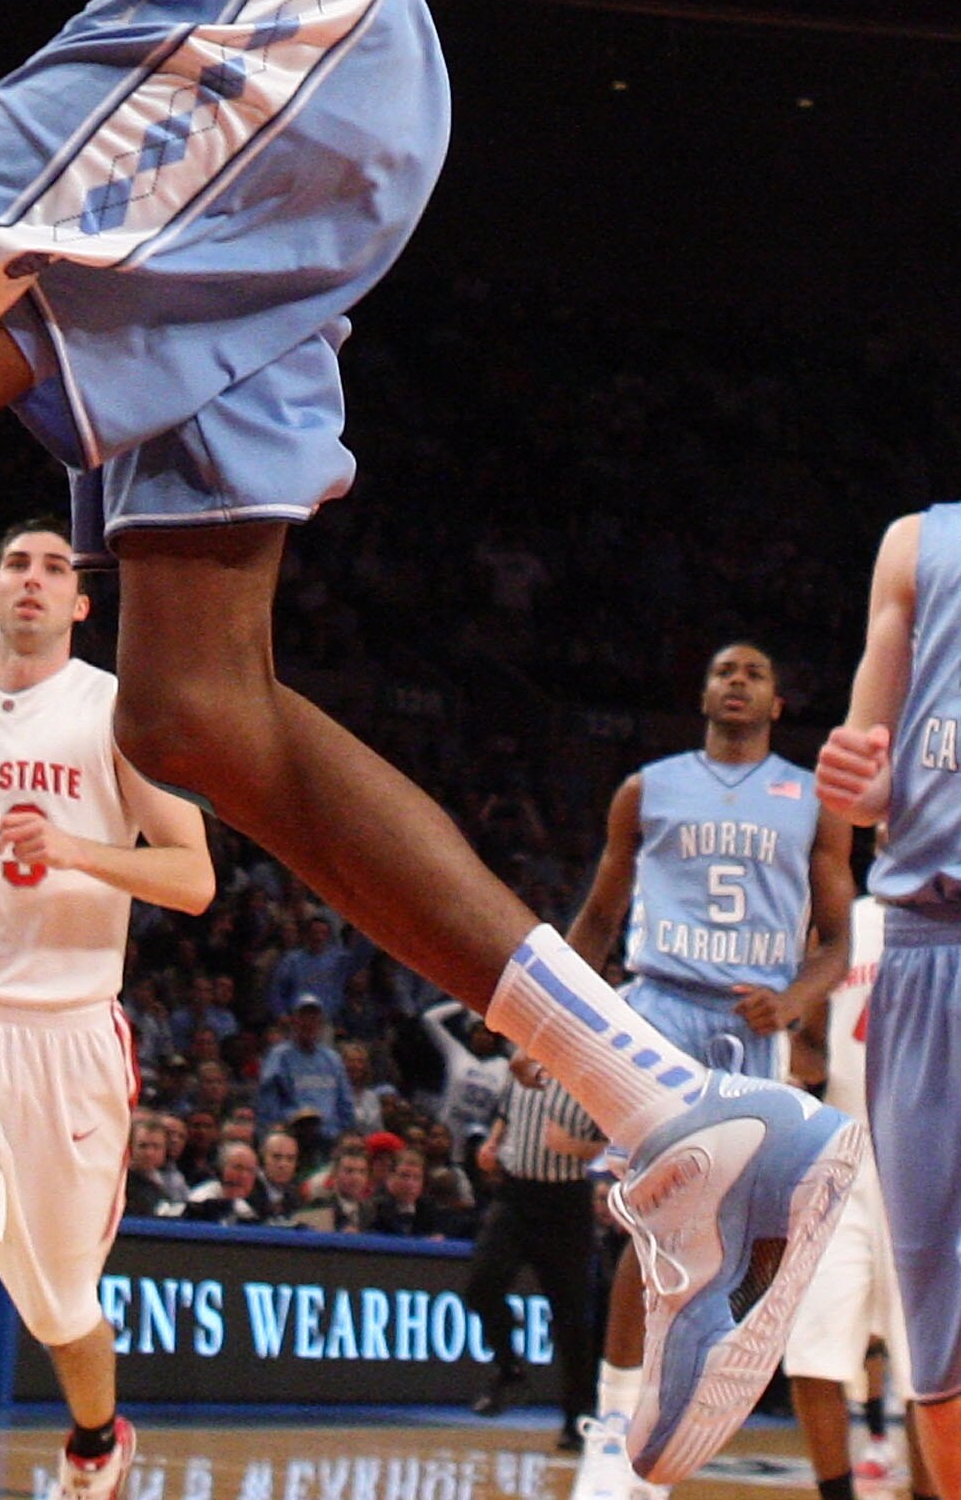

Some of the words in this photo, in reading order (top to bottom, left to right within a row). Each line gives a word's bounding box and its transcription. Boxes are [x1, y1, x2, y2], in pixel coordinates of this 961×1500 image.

[679, 820, 778, 864] NORTH
[707, 864, 747, 925] 5
[656, 919, 788, 966] CAROLINA
[99, 1273, 225, 1358] EN'S
